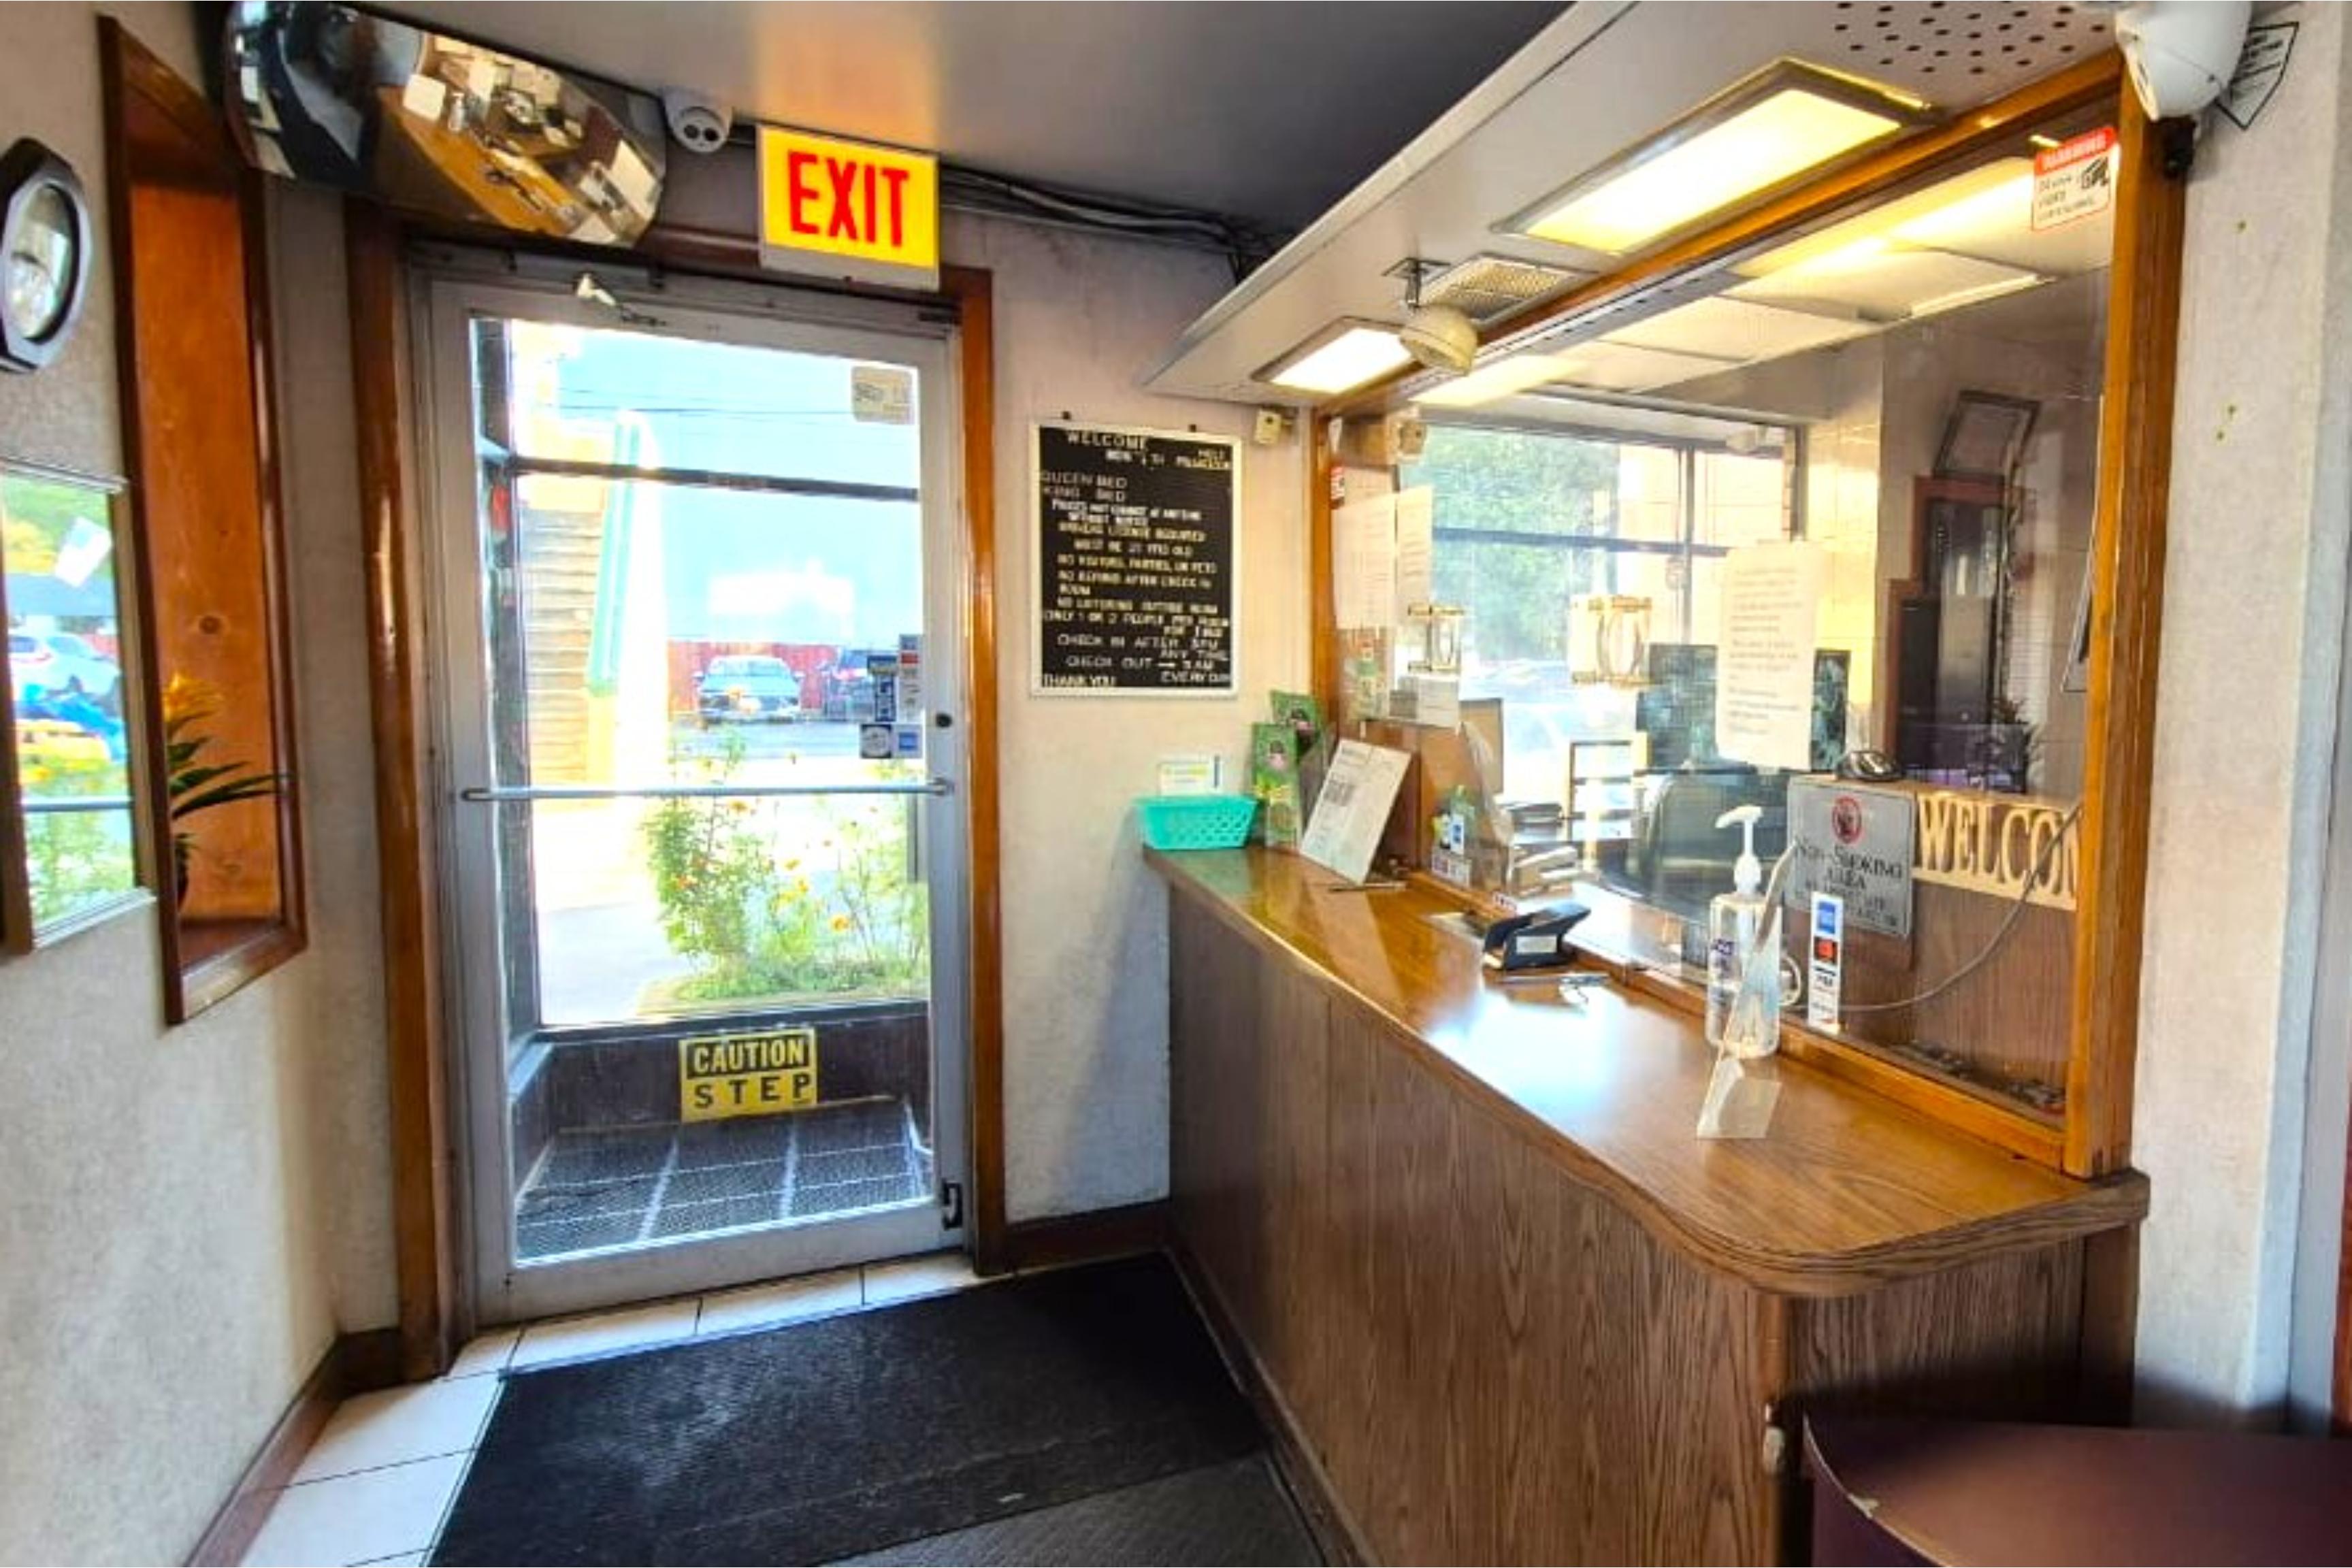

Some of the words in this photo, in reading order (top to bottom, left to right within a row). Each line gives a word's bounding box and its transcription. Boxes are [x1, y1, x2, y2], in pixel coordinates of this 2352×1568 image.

[787, 150, 910, 248] EXIT
[1067, 429, 1146, 450] WELCOME
[1096, 474, 1128, 489] BED
[1095, 488, 1126, 502] BED
[1044, 610, 1073, 622] ONLY
[1121, 657, 1154, 670] OUT
[1089, 675, 1117, 687] YOU
[693, 1039, 804, 1073] CAUTION
[693, 1073, 810, 1109] STEP
